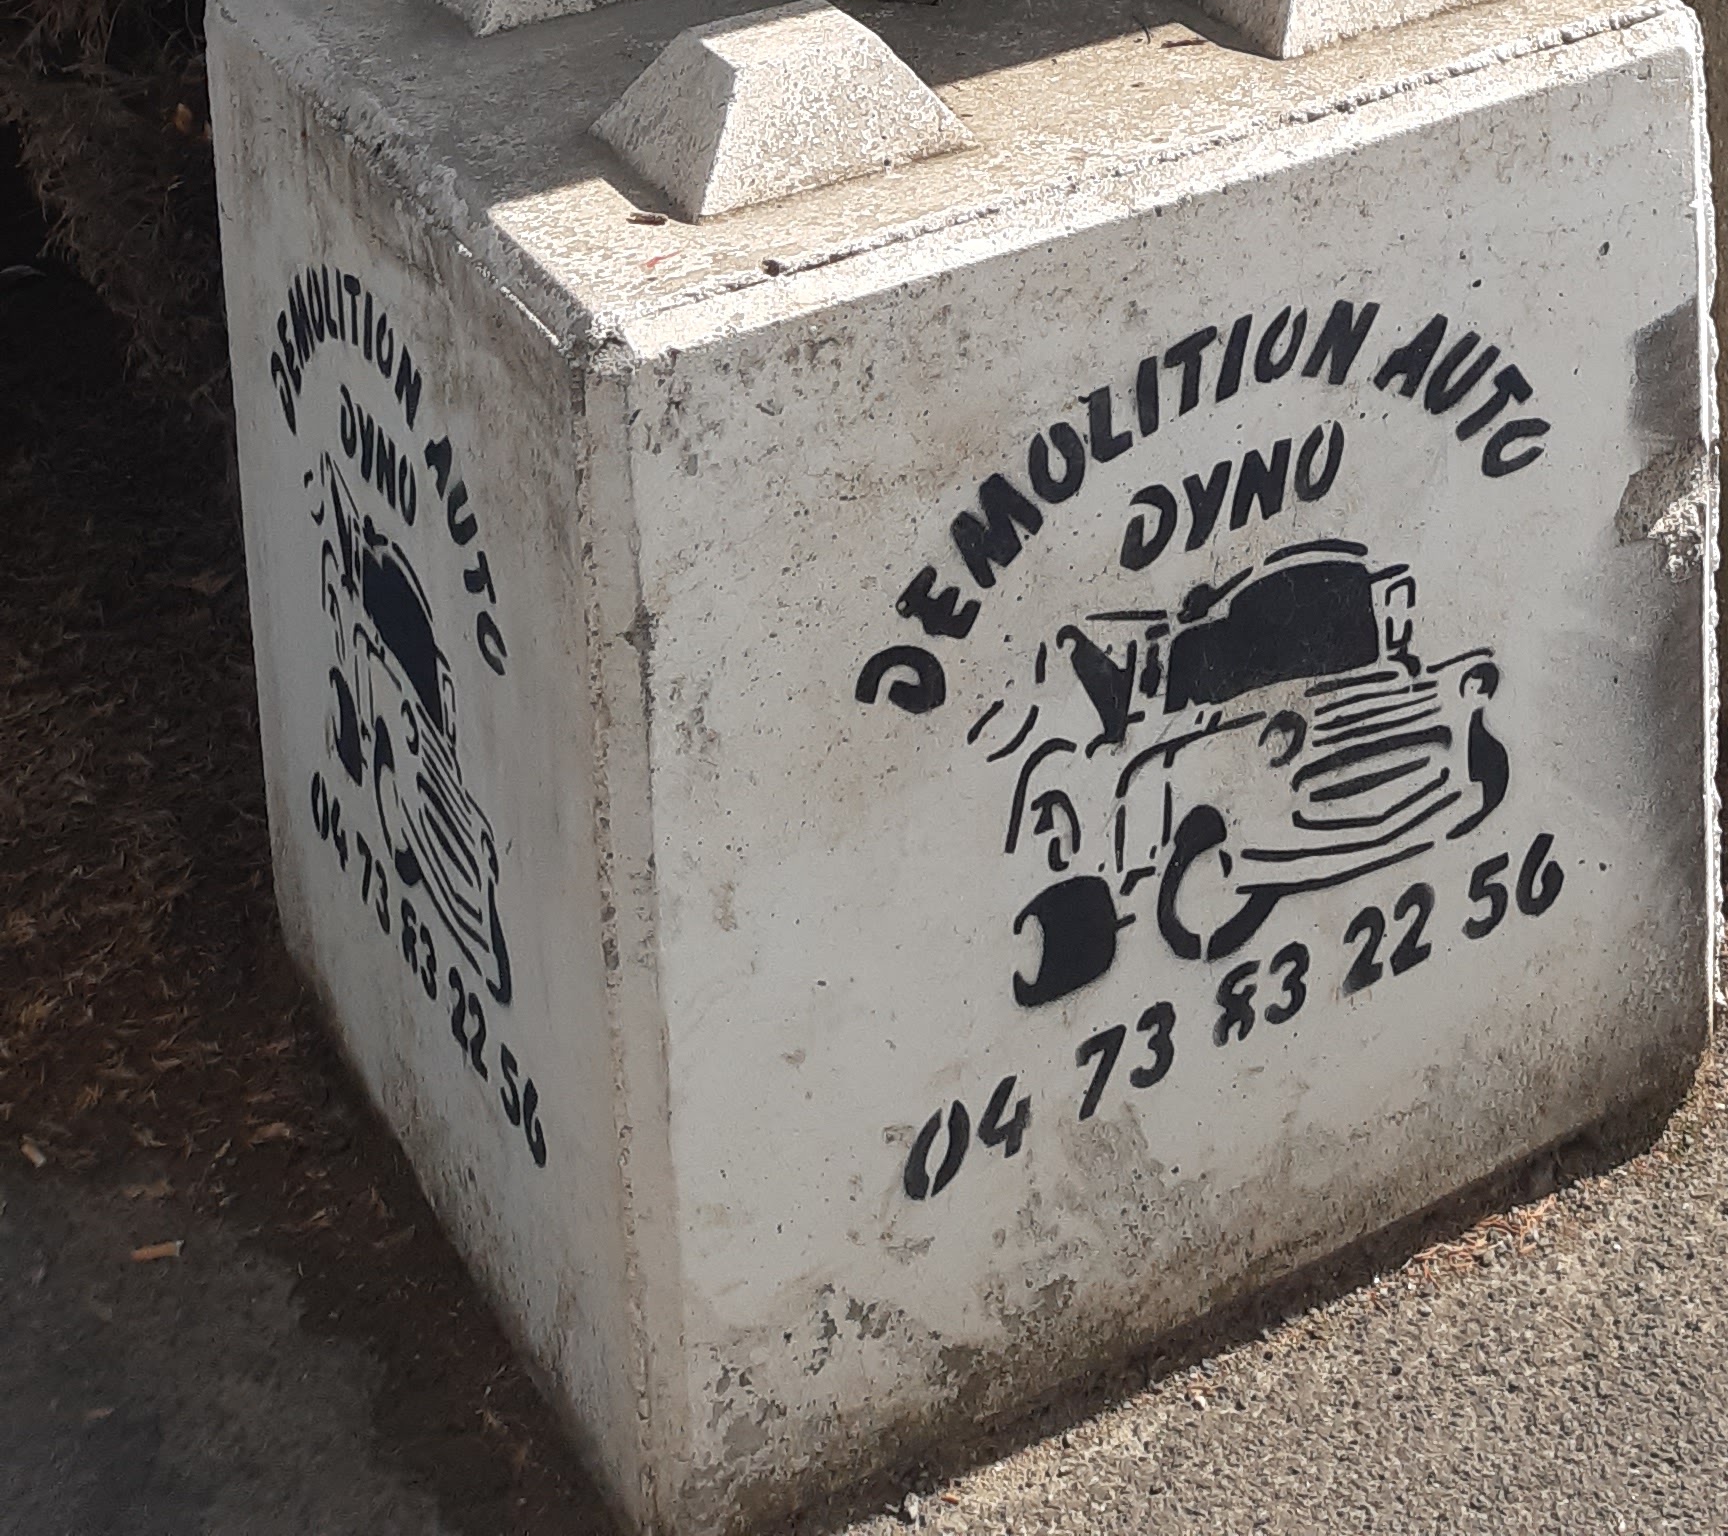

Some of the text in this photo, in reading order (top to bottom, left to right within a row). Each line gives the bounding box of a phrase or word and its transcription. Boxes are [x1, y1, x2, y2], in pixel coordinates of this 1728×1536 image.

[856, 300, 1380, 713] DEMOLITION
[1120, 421, 1346, 570] DYNO
[903, 1076, 1032, 1200] 04
[1075, 1003, 1176, 1120] 73
[1343, 882, 1436, 994] 22
[1463, 833, 1565, 940] 56
